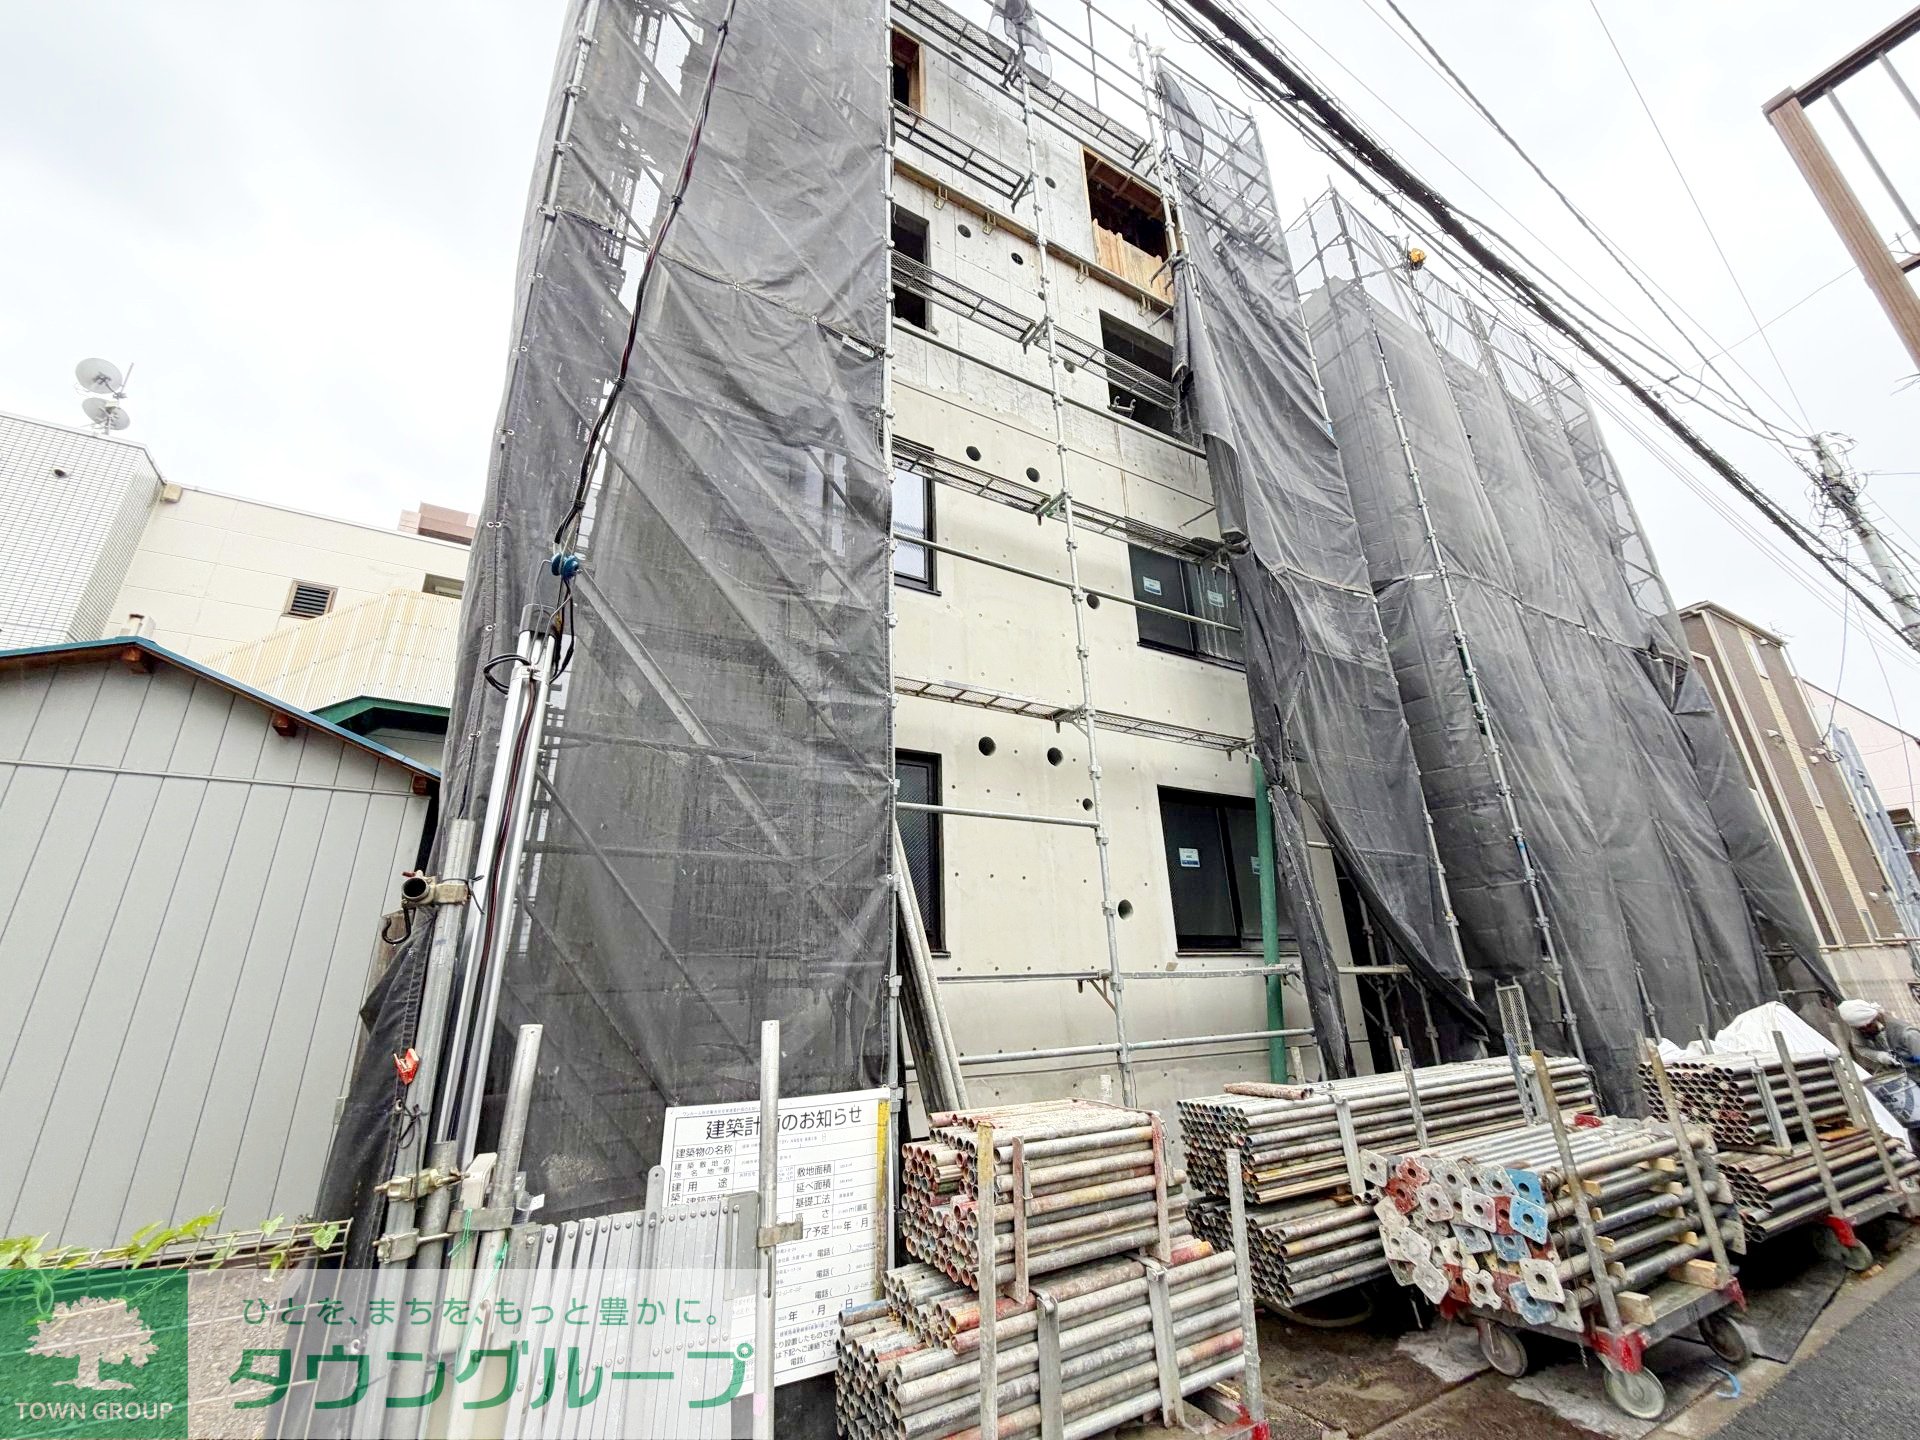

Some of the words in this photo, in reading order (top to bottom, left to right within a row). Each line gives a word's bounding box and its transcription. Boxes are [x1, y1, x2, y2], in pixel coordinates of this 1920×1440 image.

[705, 1105, 862, 1140] 建築計のお知らせ
[676, 1144, 733, 1159] 建築物の名称
[797, 1163, 832, 1178] 敷地面積
[796, 1178, 831, 1193] 延べ面積
[795, 1193, 831, 1209] 基礎工法
[804, 1224, 831, 1240] 了予定
